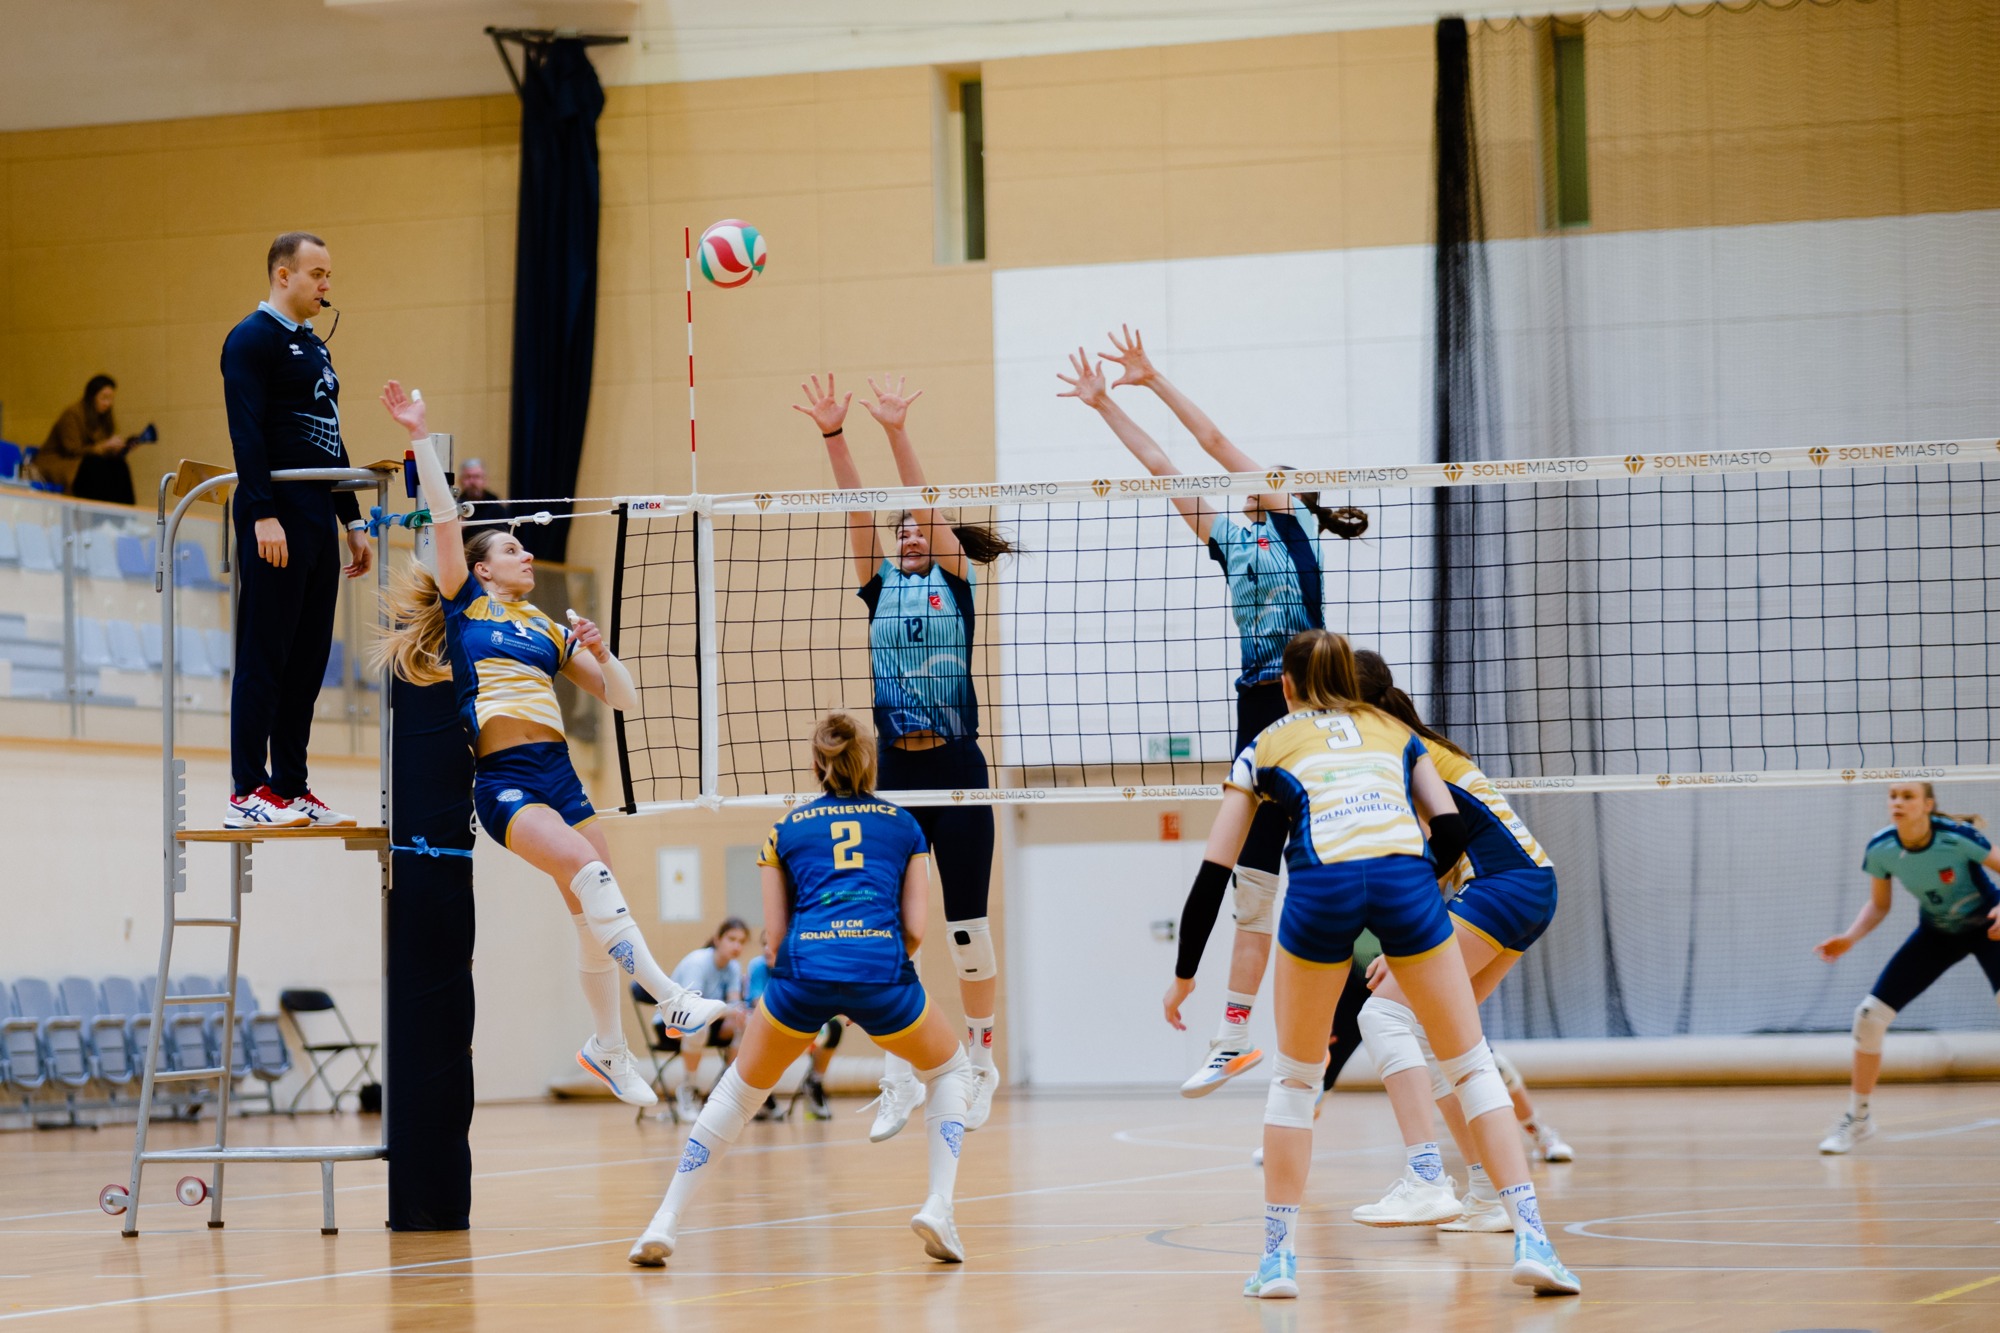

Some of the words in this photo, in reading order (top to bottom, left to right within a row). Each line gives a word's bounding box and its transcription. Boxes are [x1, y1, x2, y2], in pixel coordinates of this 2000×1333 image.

[1838, 442, 1959, 460] SOLNEMIASTO
[1472, 459, 1588, 477] SOLNEMIASTO
[1653, 451, 1772, 469] SOLNEMIASTO
[1119, 475, 1232, 493] SOLNEMIASTO
[1294, 467, 1408, 485] SOLNEMIASTO
[780, 490, 888, 507] SOLNEMIASTO
[948, 482, 1058, 500] SOLNEMIASTO
[632, 501, 661, 510] netex
[903, 617, 924, 643] 12
[1313, 714, 1364, 751] 3
[1676, 773, 1759, 786] SOLNEMIASTO
[1861, 767, 1946, 780] SOLNEMIASTO
[1140, 786, 1219, 798] SOLNEMIASTO
[1495, 778, 1576, 790] SOLNEMIASTO
[969, 790, 1047, 801] SOLNEMIASTO
[1362, 791, 1381, 801] CM
[791, 803, 898, 824] DUTKIEWICZ
[1313, 809, 1352, 826] SOLNA
[830, 820, 864, 870] 2
[845, 919, 864, 929] CM
[800, 931, 836, 941] SOLNA
[837, 929, 893, 940] WIELICZKA
